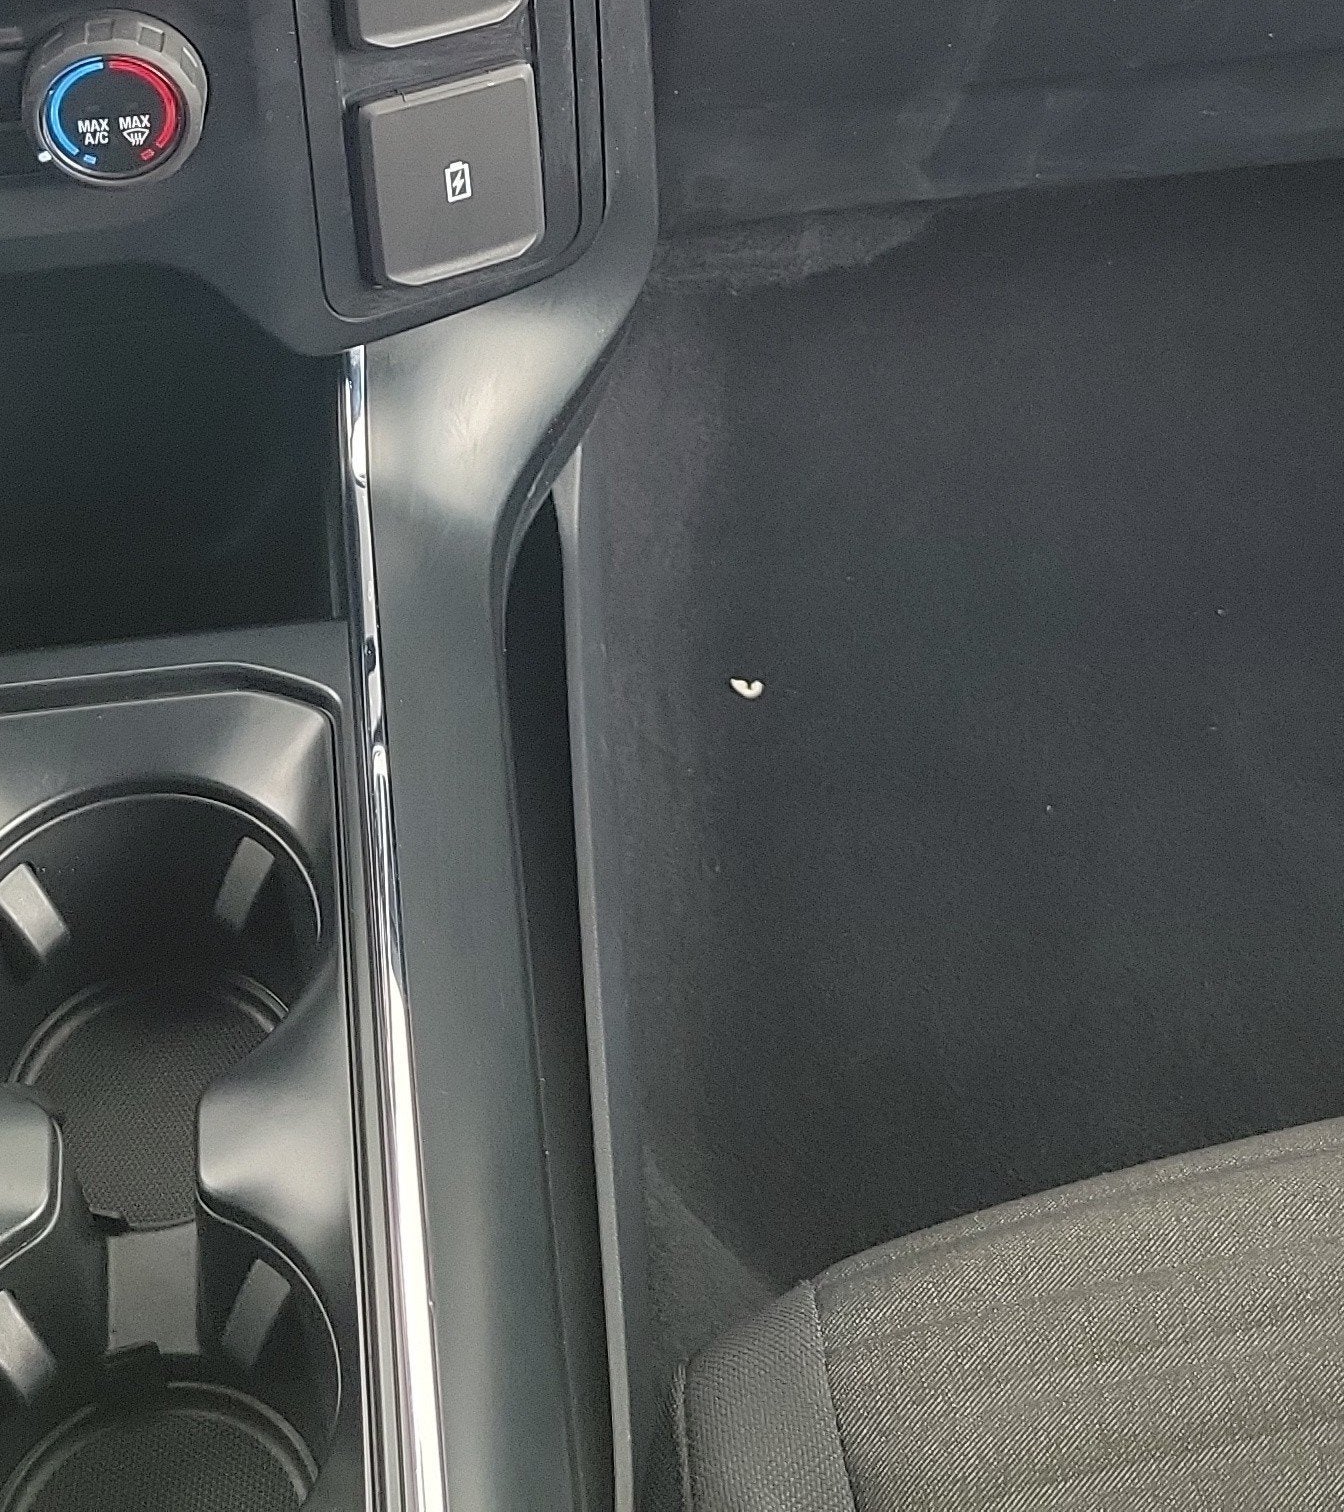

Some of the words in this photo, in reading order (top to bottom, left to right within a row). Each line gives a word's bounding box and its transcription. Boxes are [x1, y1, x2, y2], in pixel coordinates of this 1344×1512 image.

[77, 119, 108, 133] MAX
[119, 115, 151, 130] MAX
[84, 131, 109, 145] A/C
